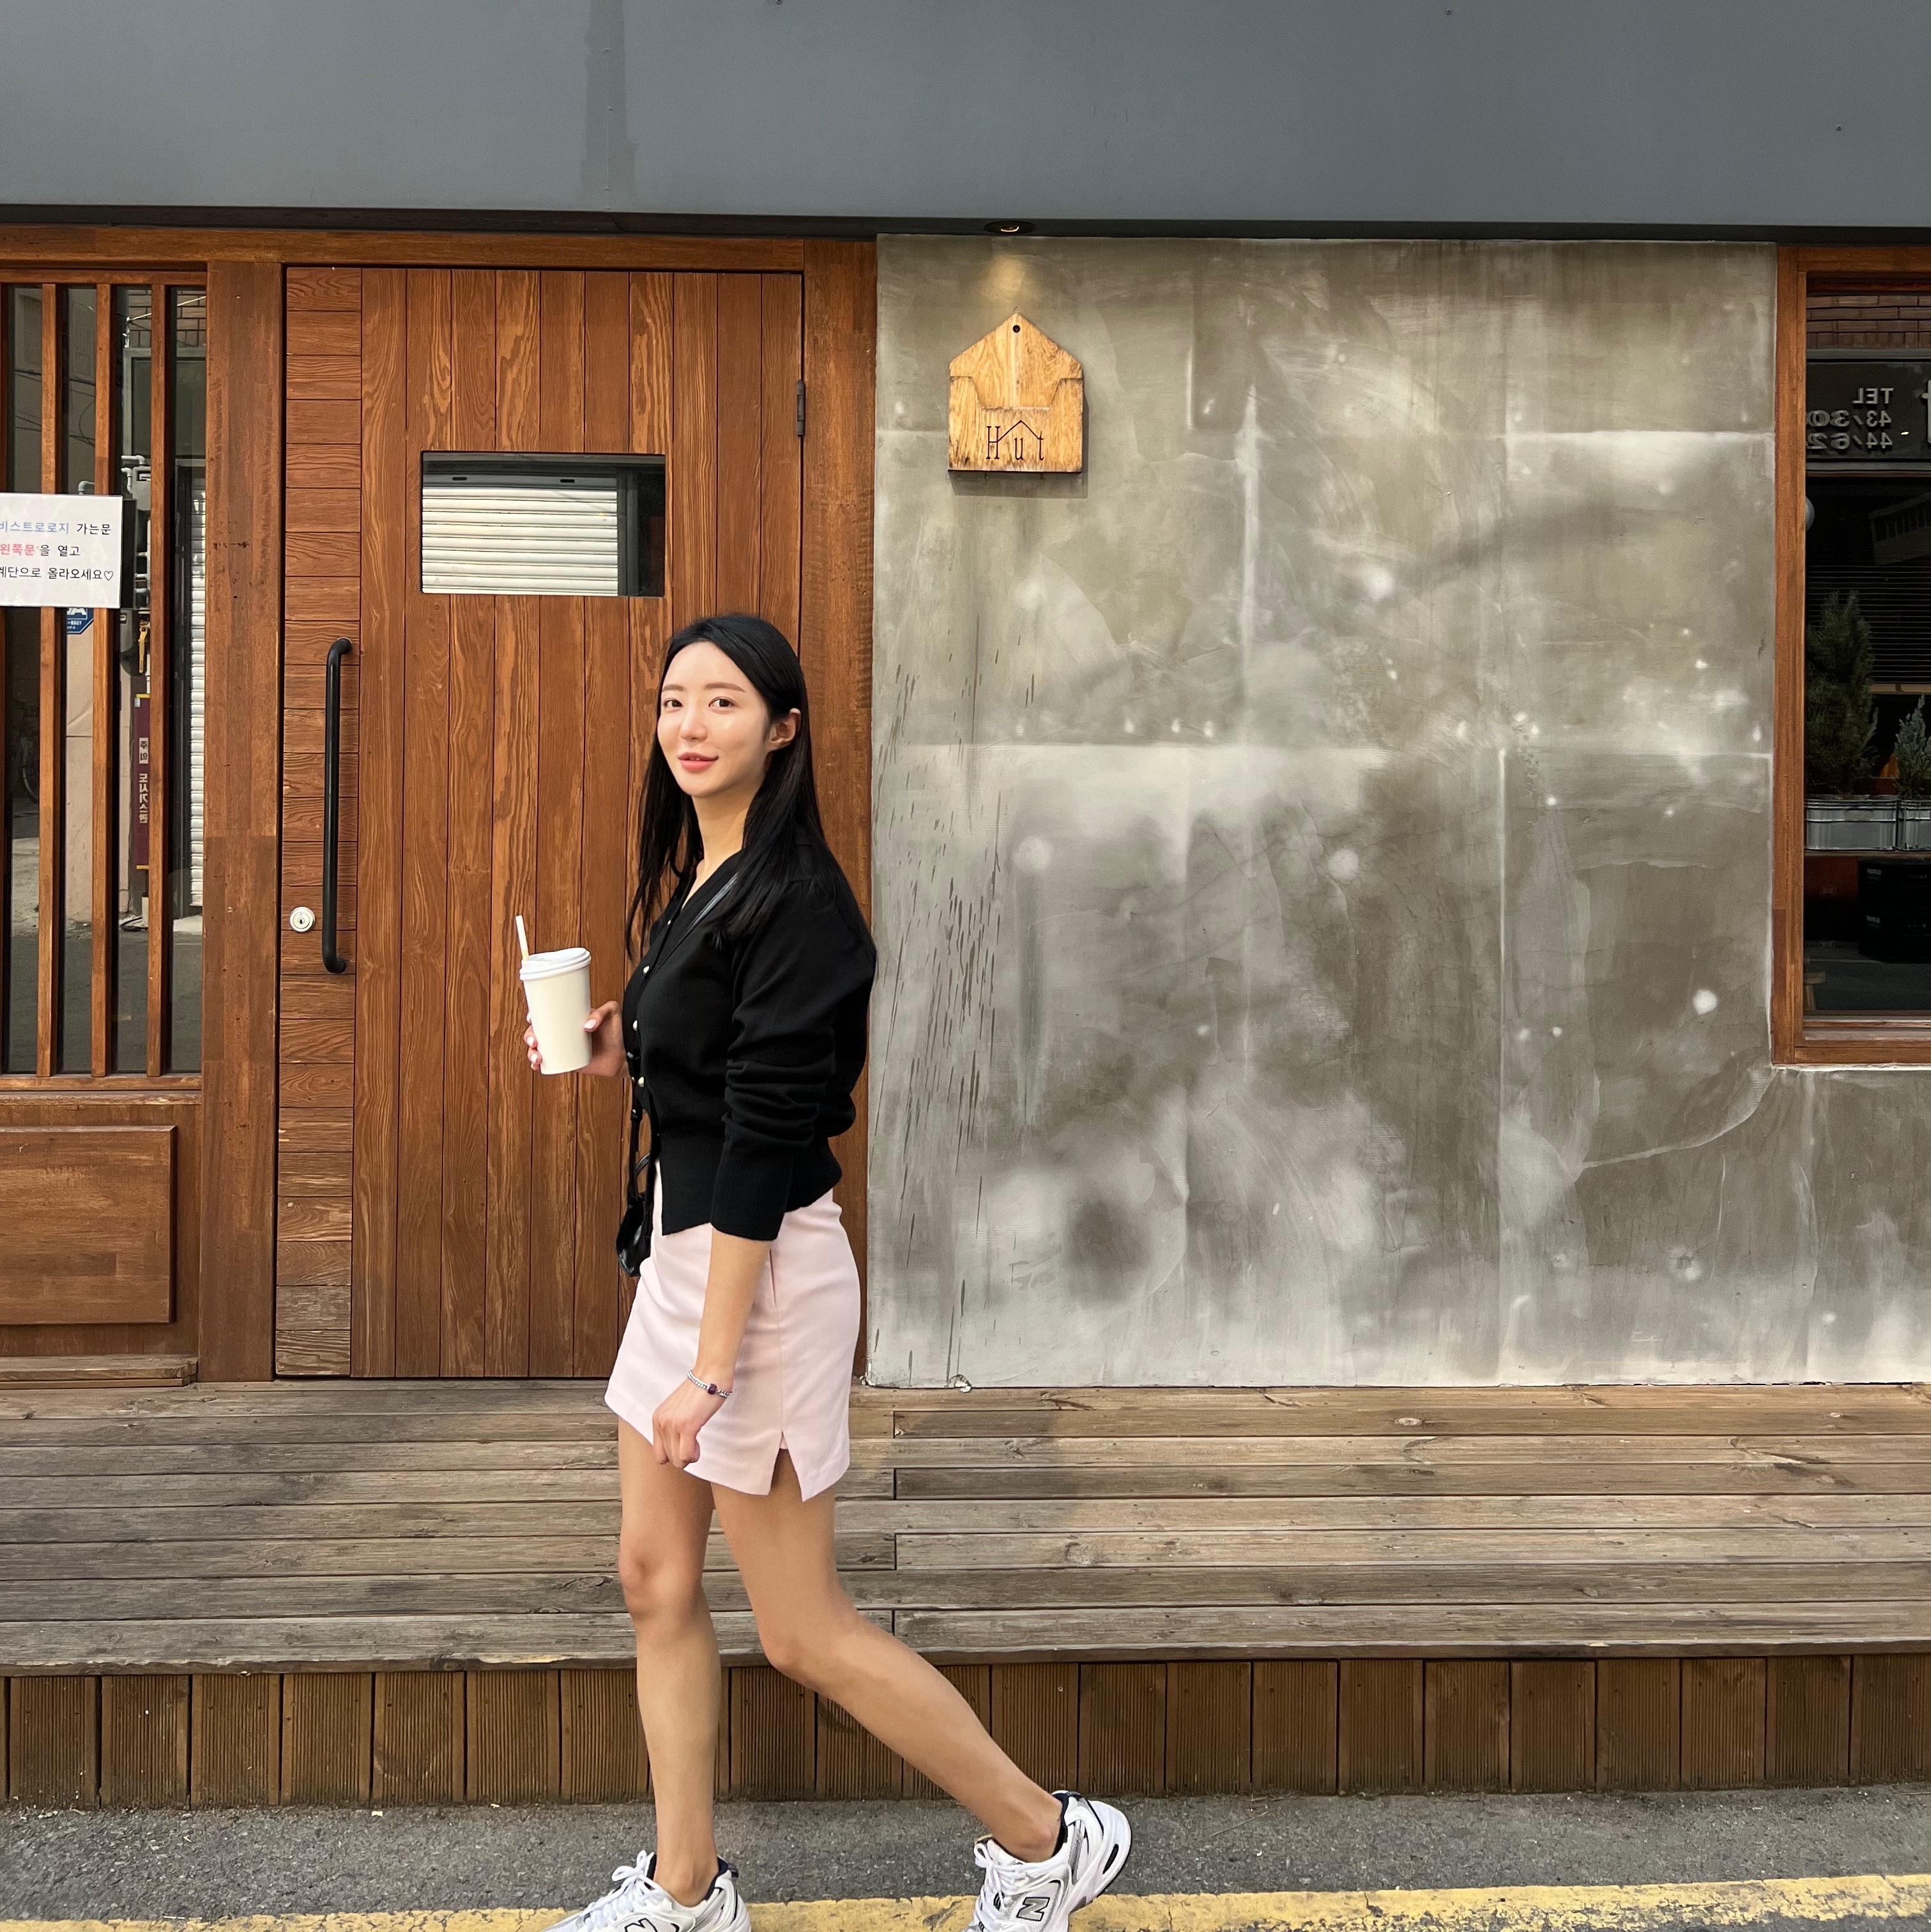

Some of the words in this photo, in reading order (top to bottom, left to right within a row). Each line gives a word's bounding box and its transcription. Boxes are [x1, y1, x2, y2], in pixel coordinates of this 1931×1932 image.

[986, 420, 1044, 461] Hut
[0, 521, 69, 534] 비스트로로지
[77, 523, 111, 535] 가는문
[58, 545, 80, 556] 열고
